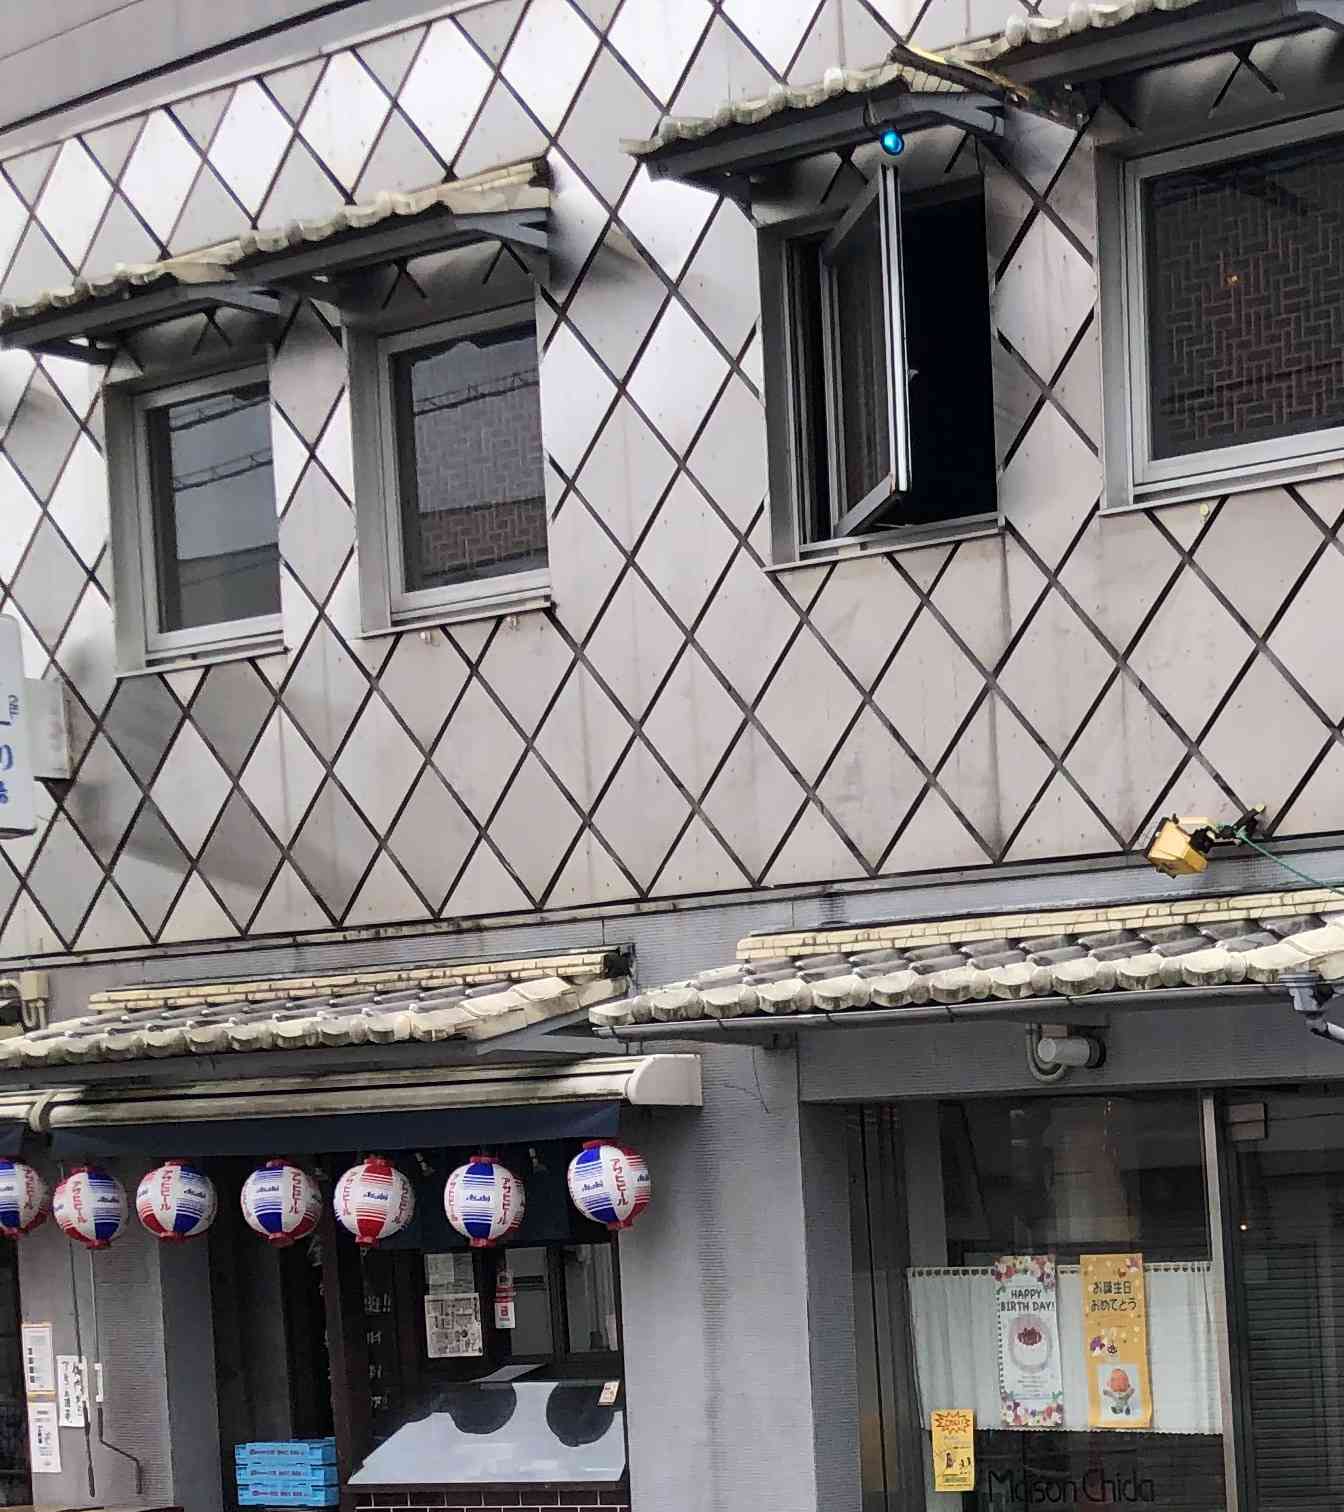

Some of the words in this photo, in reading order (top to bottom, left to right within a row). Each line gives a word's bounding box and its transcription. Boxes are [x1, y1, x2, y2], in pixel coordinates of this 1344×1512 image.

[465, 1192, 491, 1202] Asahi
[1011, 1288, 1042, 1300] HAPPY
[1092, 1281, 1132, 1295] お誕生日
[1001, 1301, 1029, 1313] BIRTH
[1033, 1300, 1055, 1312] DAY!
[1090, 1298, 1137, 1313] おめでとう
[988, 1469, 1078, 1503] Maison
[1082, 1468, 1154, 1503] Chida
